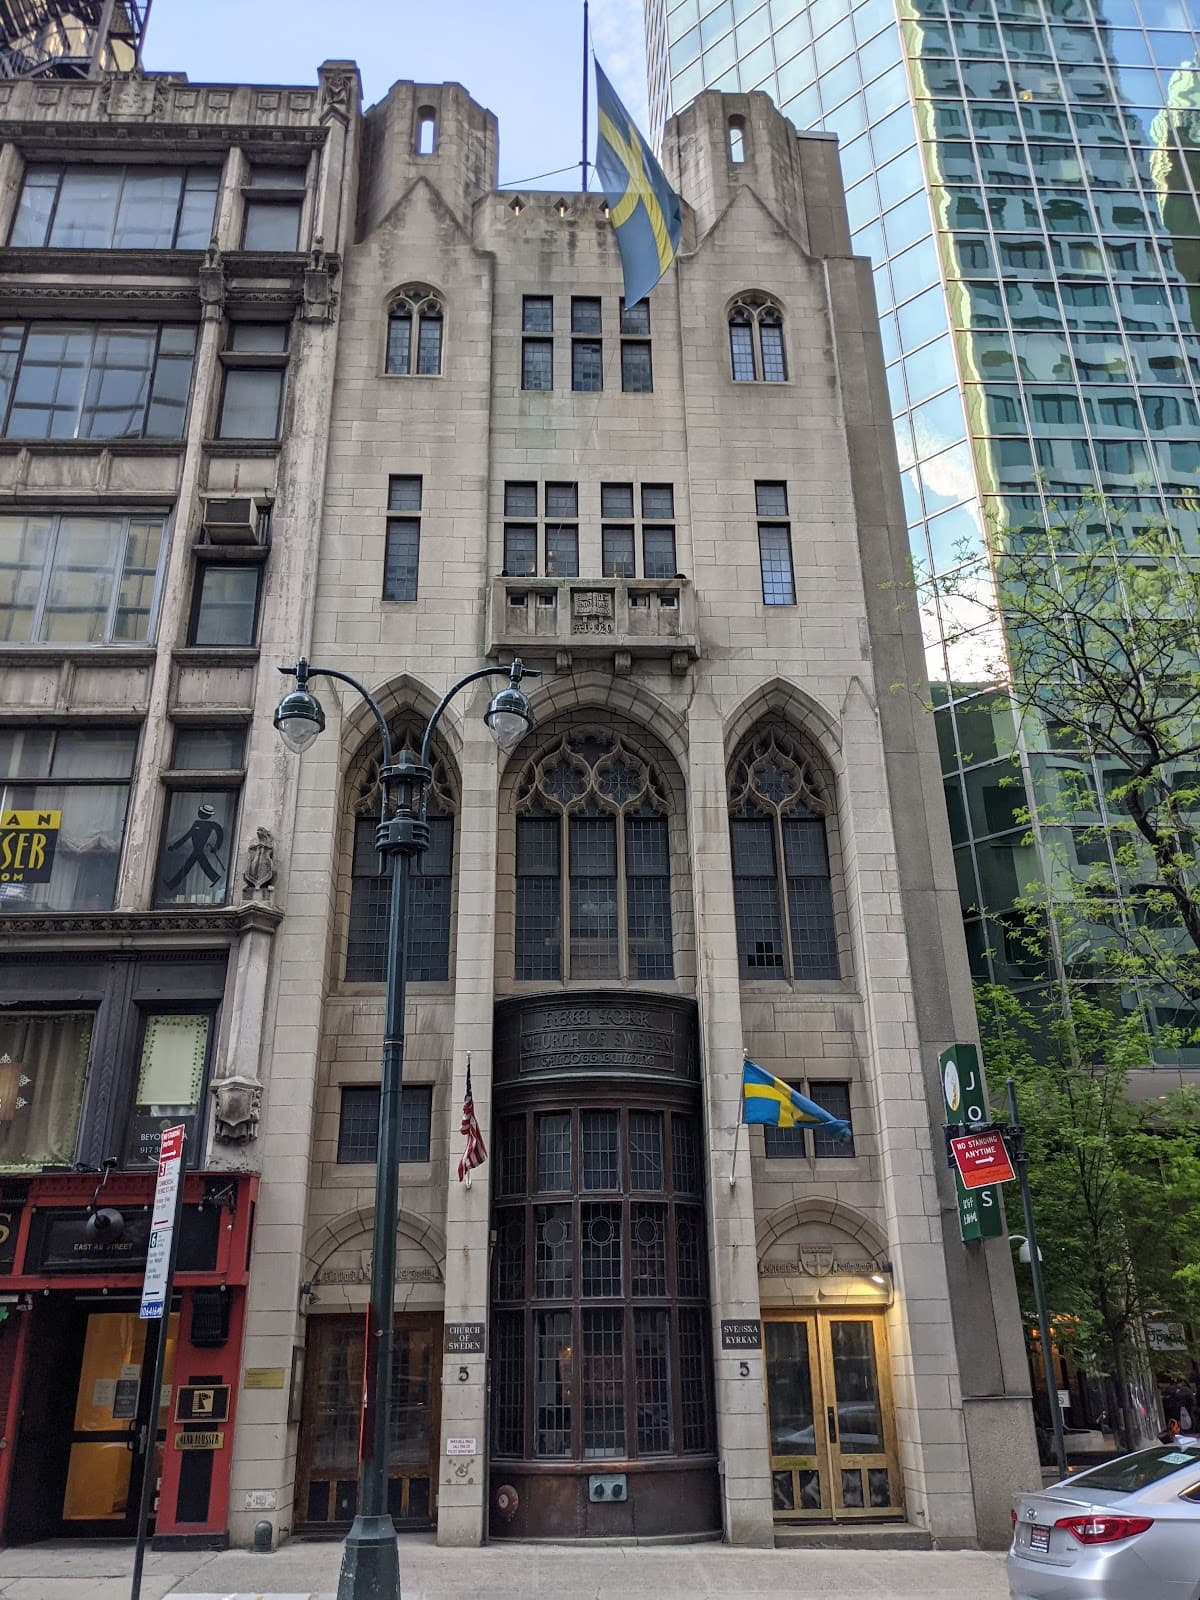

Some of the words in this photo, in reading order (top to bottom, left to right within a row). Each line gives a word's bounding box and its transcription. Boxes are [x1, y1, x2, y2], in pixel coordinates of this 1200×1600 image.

[0, 831, 47, 870] SER
[523, 1033, 580, 1053] CHURCH
[615, 1031, 673, 1053] SWEDEN
[956, 1142, 966, 1151] NO
[968, 1135, 998, 1149] STANDING
[965, 1146, 997, 1160] ANYTIME
[449, 1326, 481, 1335] CHURCH
[723, 1325, 759, 1333] SVENSKA
[459, 1334, 471, 1342] OF
[725, 1335, 759, 1344] KYRKAN
[448, 1341, 481, 1350] SWEDEN
[458, 1366, 470, 1382] 5
[739, 1361, 750, 1377] 5
